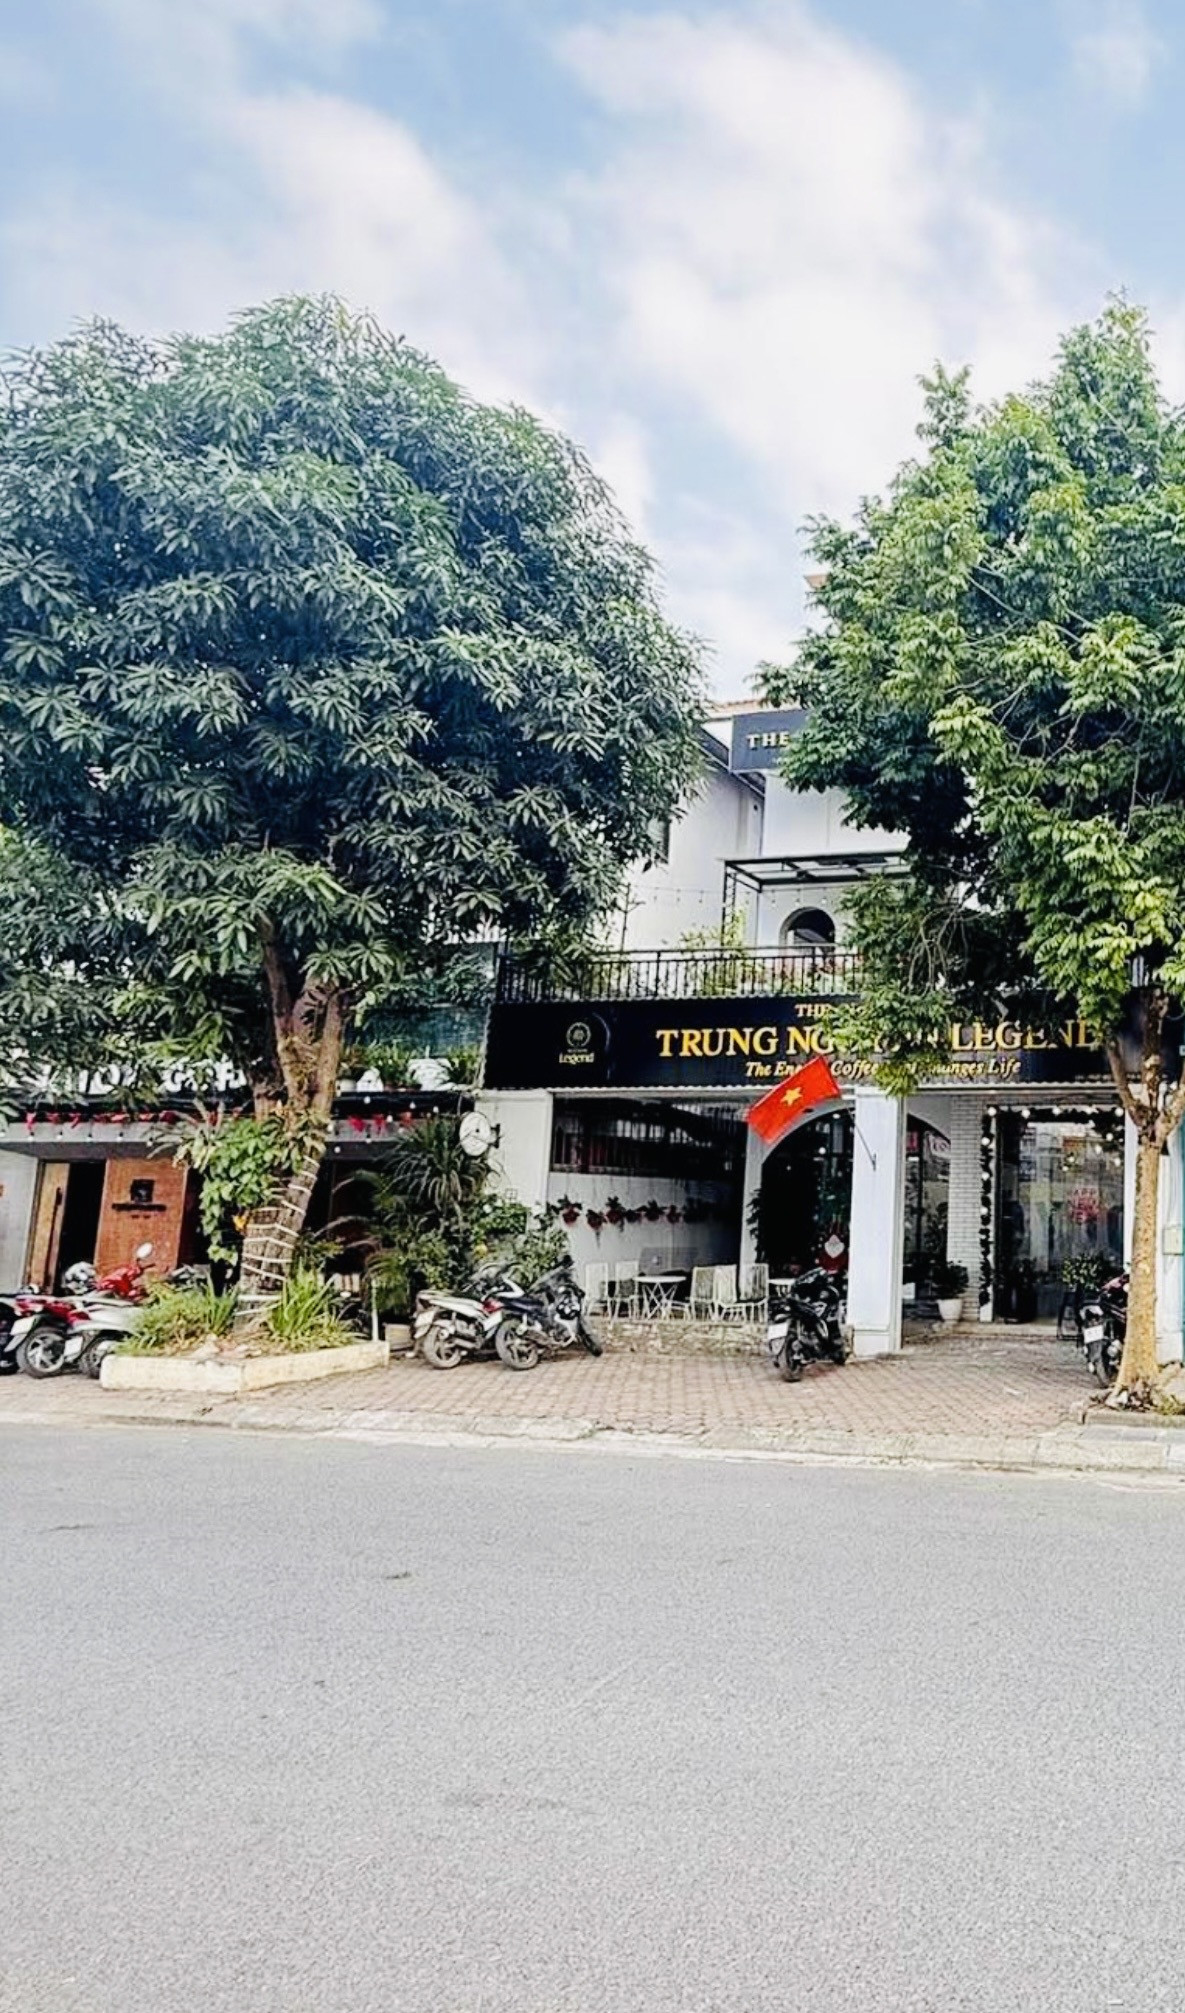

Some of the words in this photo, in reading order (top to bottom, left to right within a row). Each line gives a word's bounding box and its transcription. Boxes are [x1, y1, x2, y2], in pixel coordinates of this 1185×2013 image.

[746, 731, 790, 748] THE
[655, 1026, 779, 1058] TRUNG
[745, 1061, 772, 1077] The
[830, 1059, 879, 1079] Coffee
[987, 1057, 1022, 1079] Life
